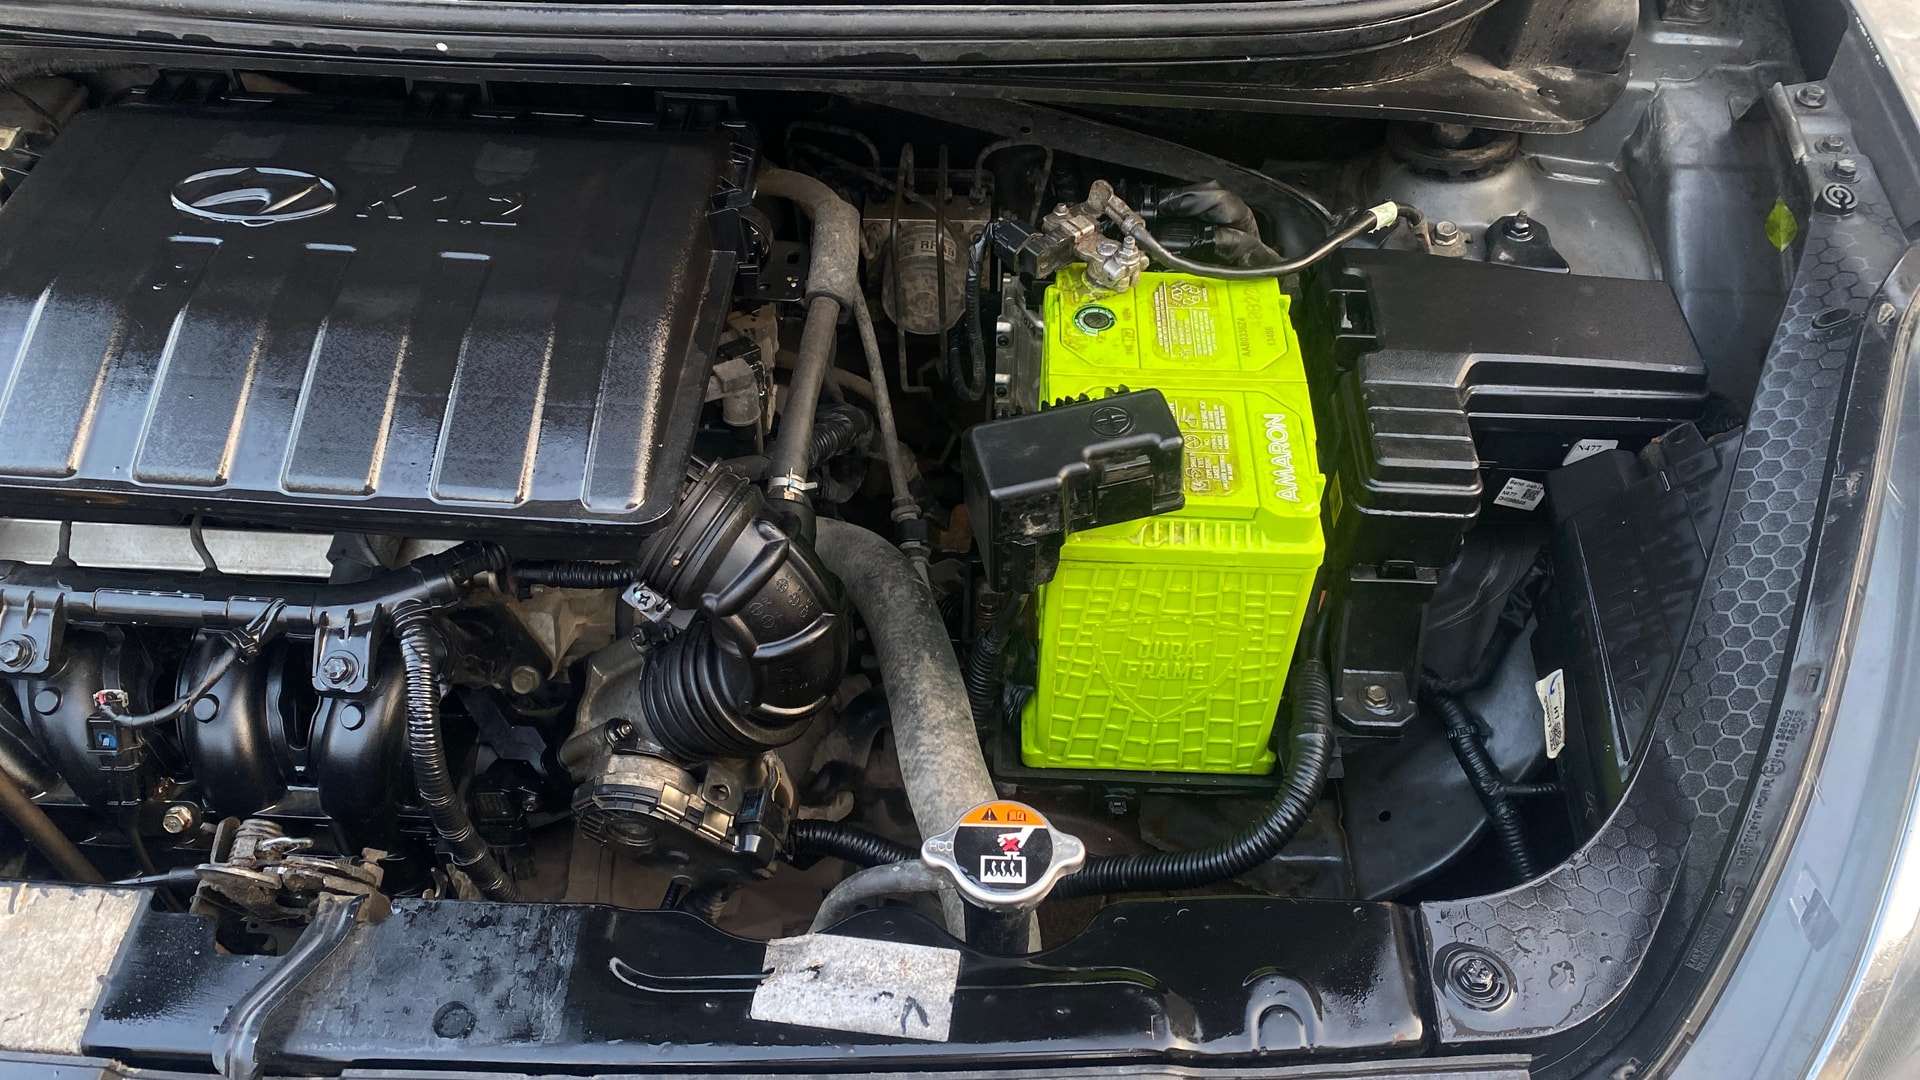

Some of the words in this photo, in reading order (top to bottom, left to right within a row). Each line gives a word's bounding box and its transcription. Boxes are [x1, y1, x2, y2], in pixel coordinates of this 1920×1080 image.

[1263, 413, 1300, 502] AMARON
[1138, 641, 1196, 660] DURA
[1126, 662, 1203, 680] FRAME
